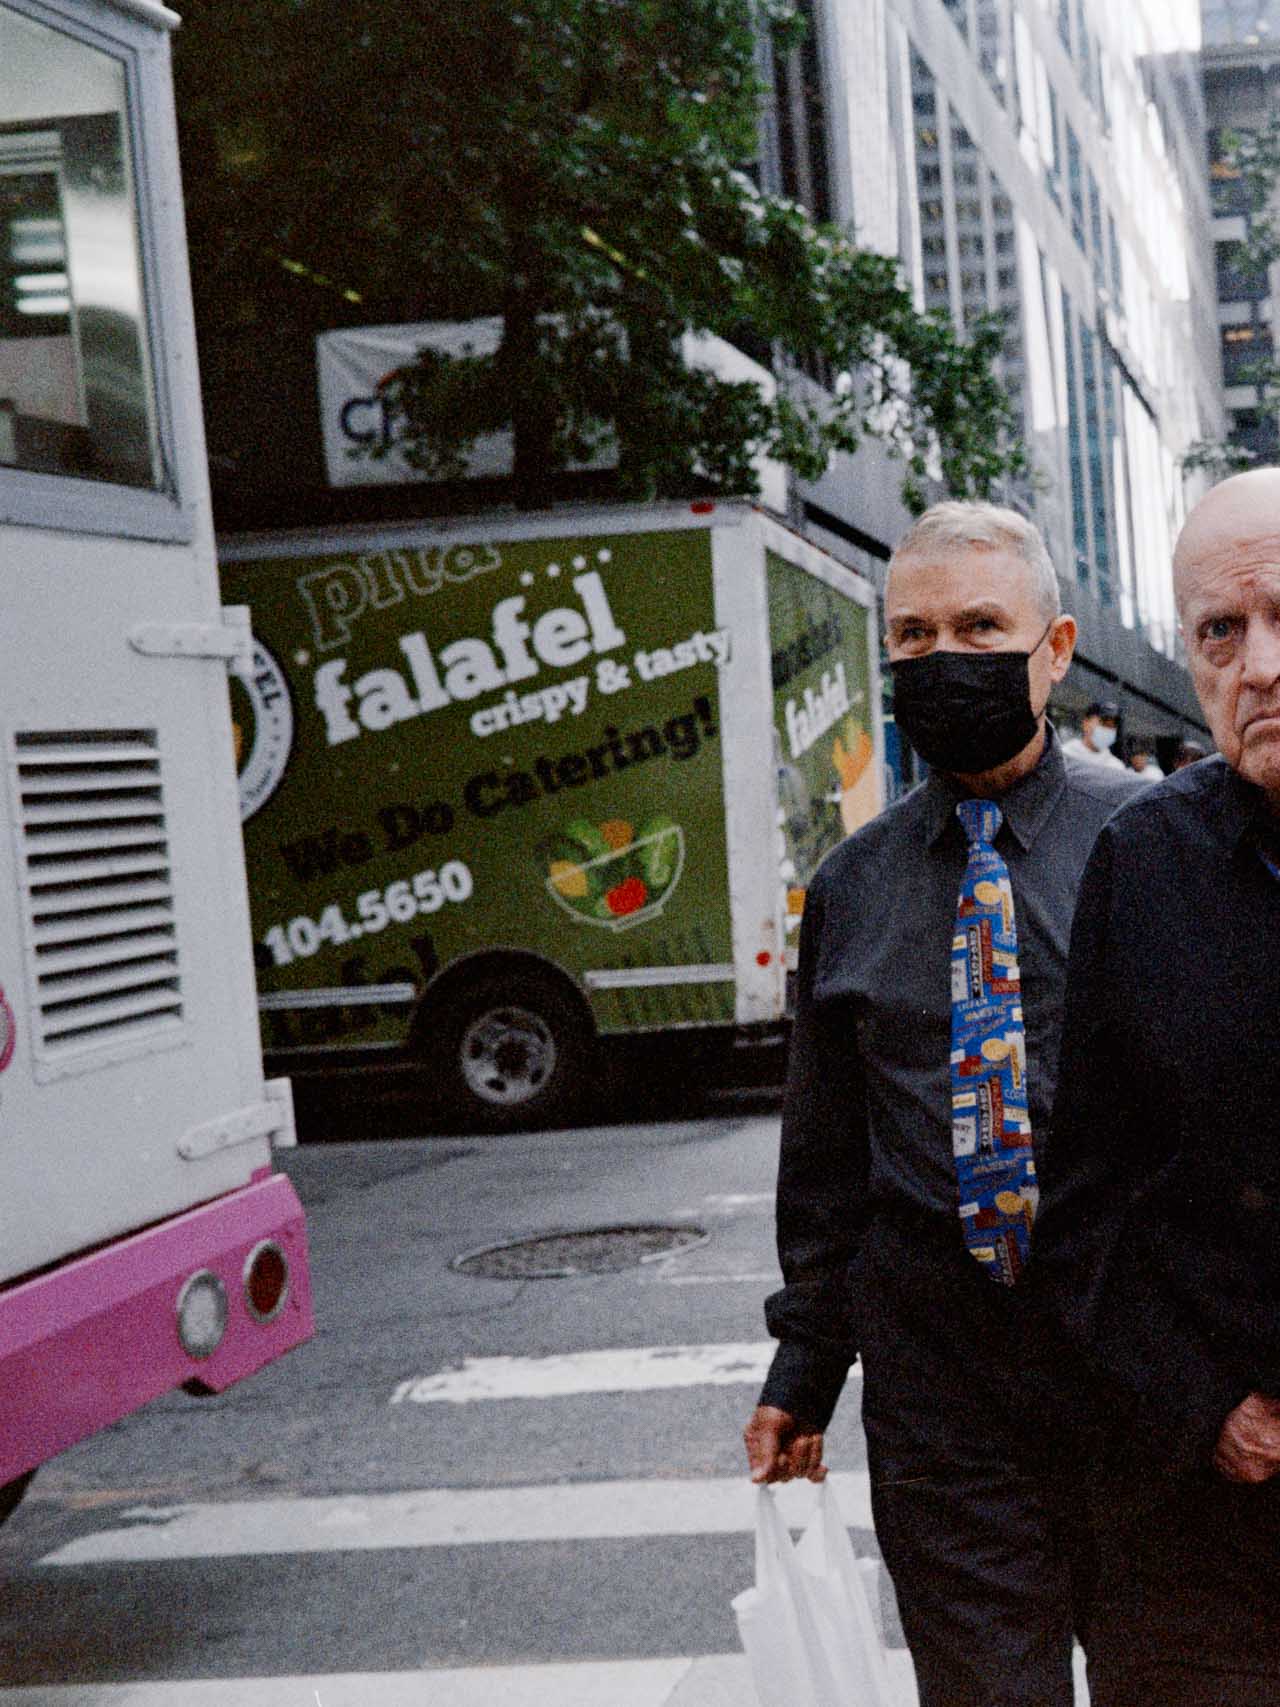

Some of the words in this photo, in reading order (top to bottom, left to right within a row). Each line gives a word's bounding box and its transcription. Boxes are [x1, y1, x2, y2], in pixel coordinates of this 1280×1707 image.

[314, 571, 626, 746] falafel
[469, 677, 589, 737] crispy
[596, 660, 631, 694] &
[634, 627, 733, 682] tasty
[377, 799, 454, 852] Do
[463, 697, 719, 818] Catering!
